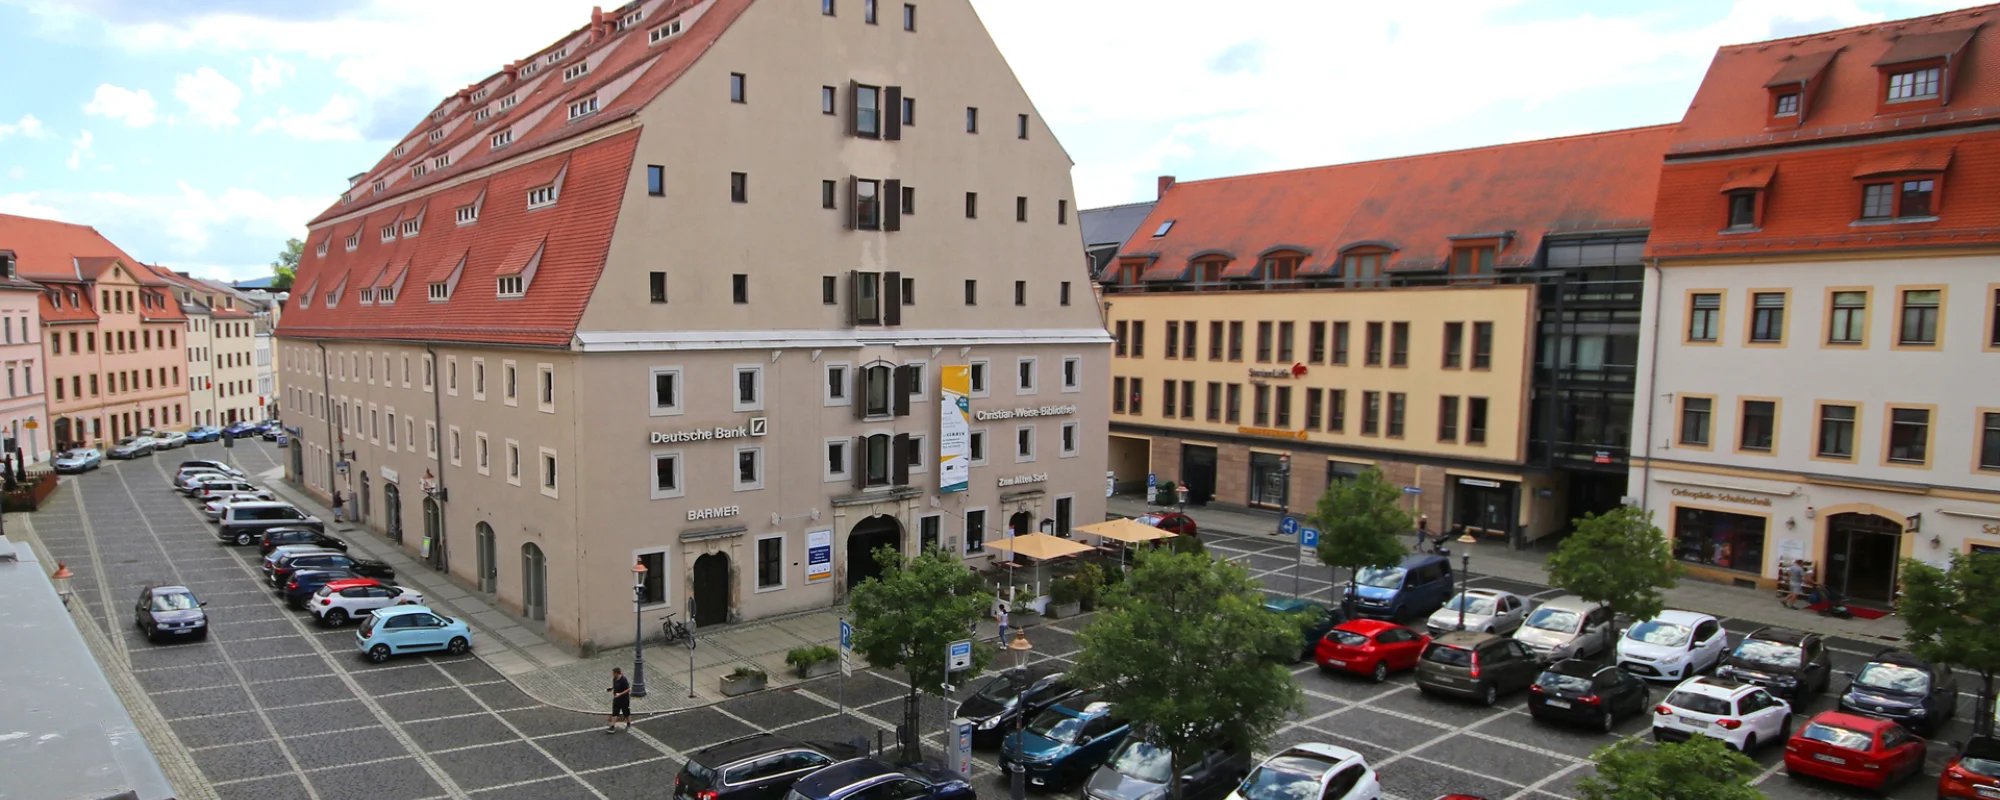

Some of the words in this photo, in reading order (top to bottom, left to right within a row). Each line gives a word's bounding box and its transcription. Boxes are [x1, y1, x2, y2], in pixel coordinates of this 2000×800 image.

[976, 404, 1077, 421] Christian-Weise-Bibliothek
[650, 428, 713, 444] Deutsche
[714, 425, 747, 440] Bank
[1014, 475, 1033, 485] Alten
[687, 505, 740, 521] BARMER
[1304, 530, 1315, 544] P
[842, 624, 849, 644] P
